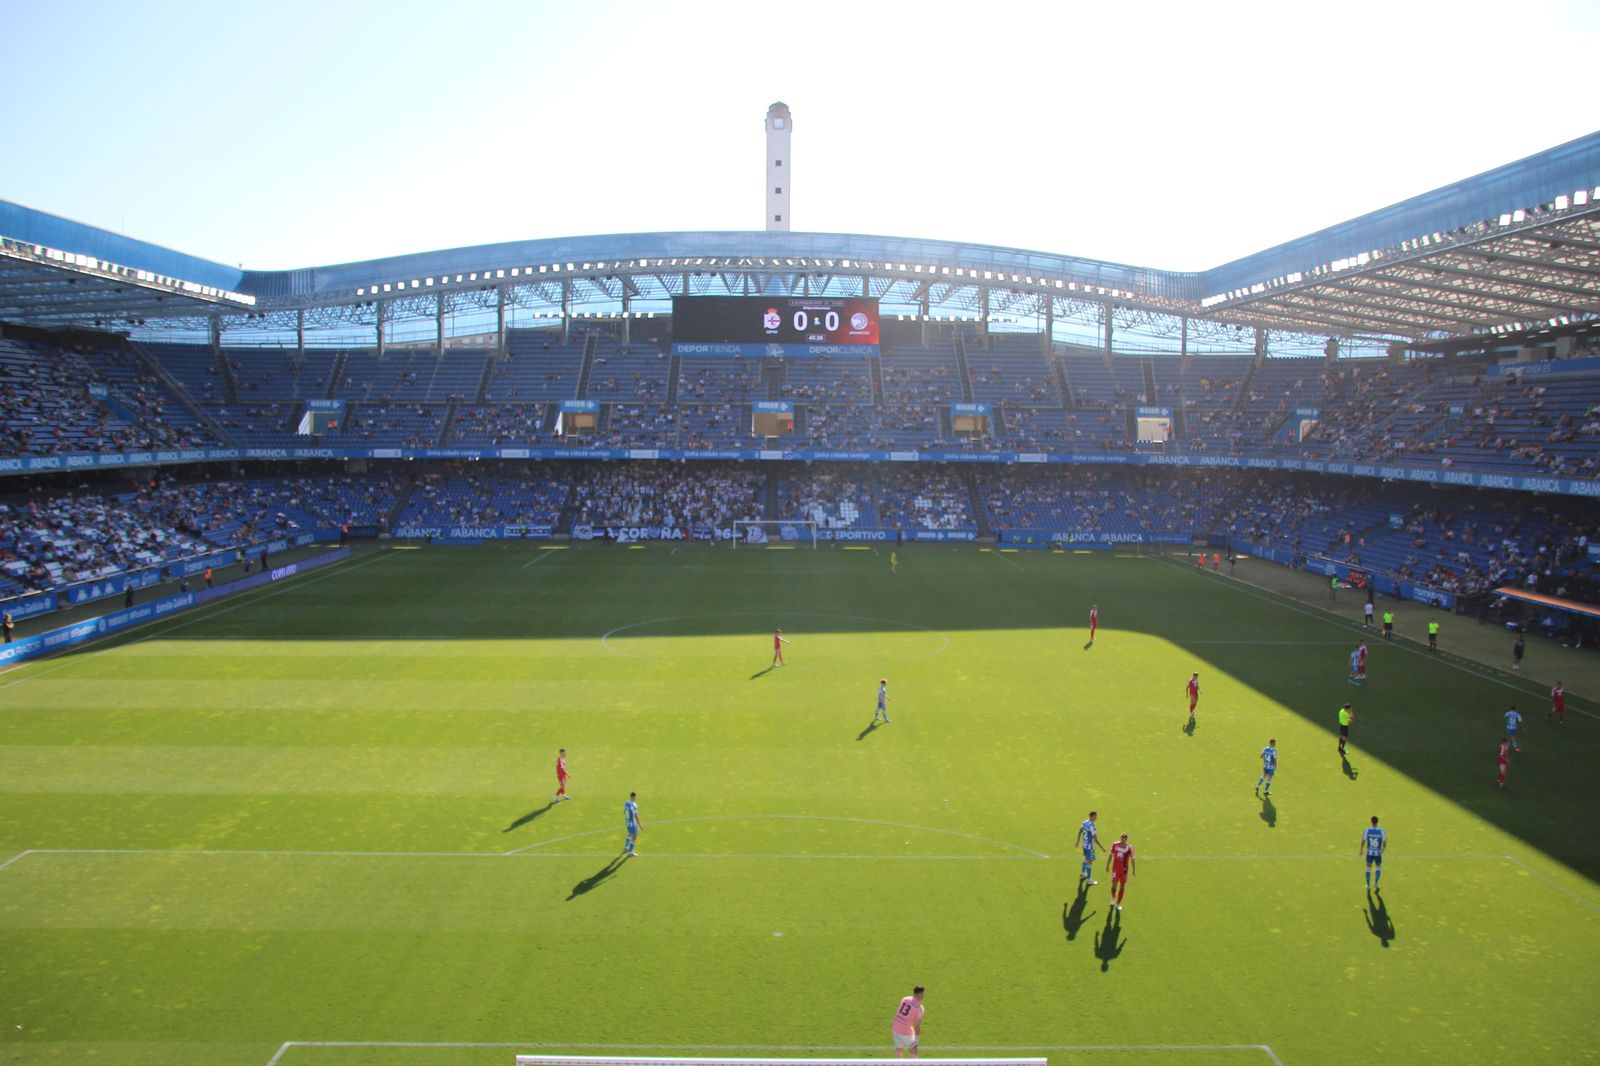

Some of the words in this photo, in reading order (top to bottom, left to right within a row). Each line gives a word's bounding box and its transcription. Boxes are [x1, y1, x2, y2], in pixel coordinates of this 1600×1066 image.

[793, 311, 808, 331] 0
[825, 311, 839, 332] 0
[1522, 477, 1561, 493] ABANCA
[451, 527, 498, 538] ABANCA
[1100, 532, 1144, 543] ABANCA
[899, 1002, 911, 1016] 13
